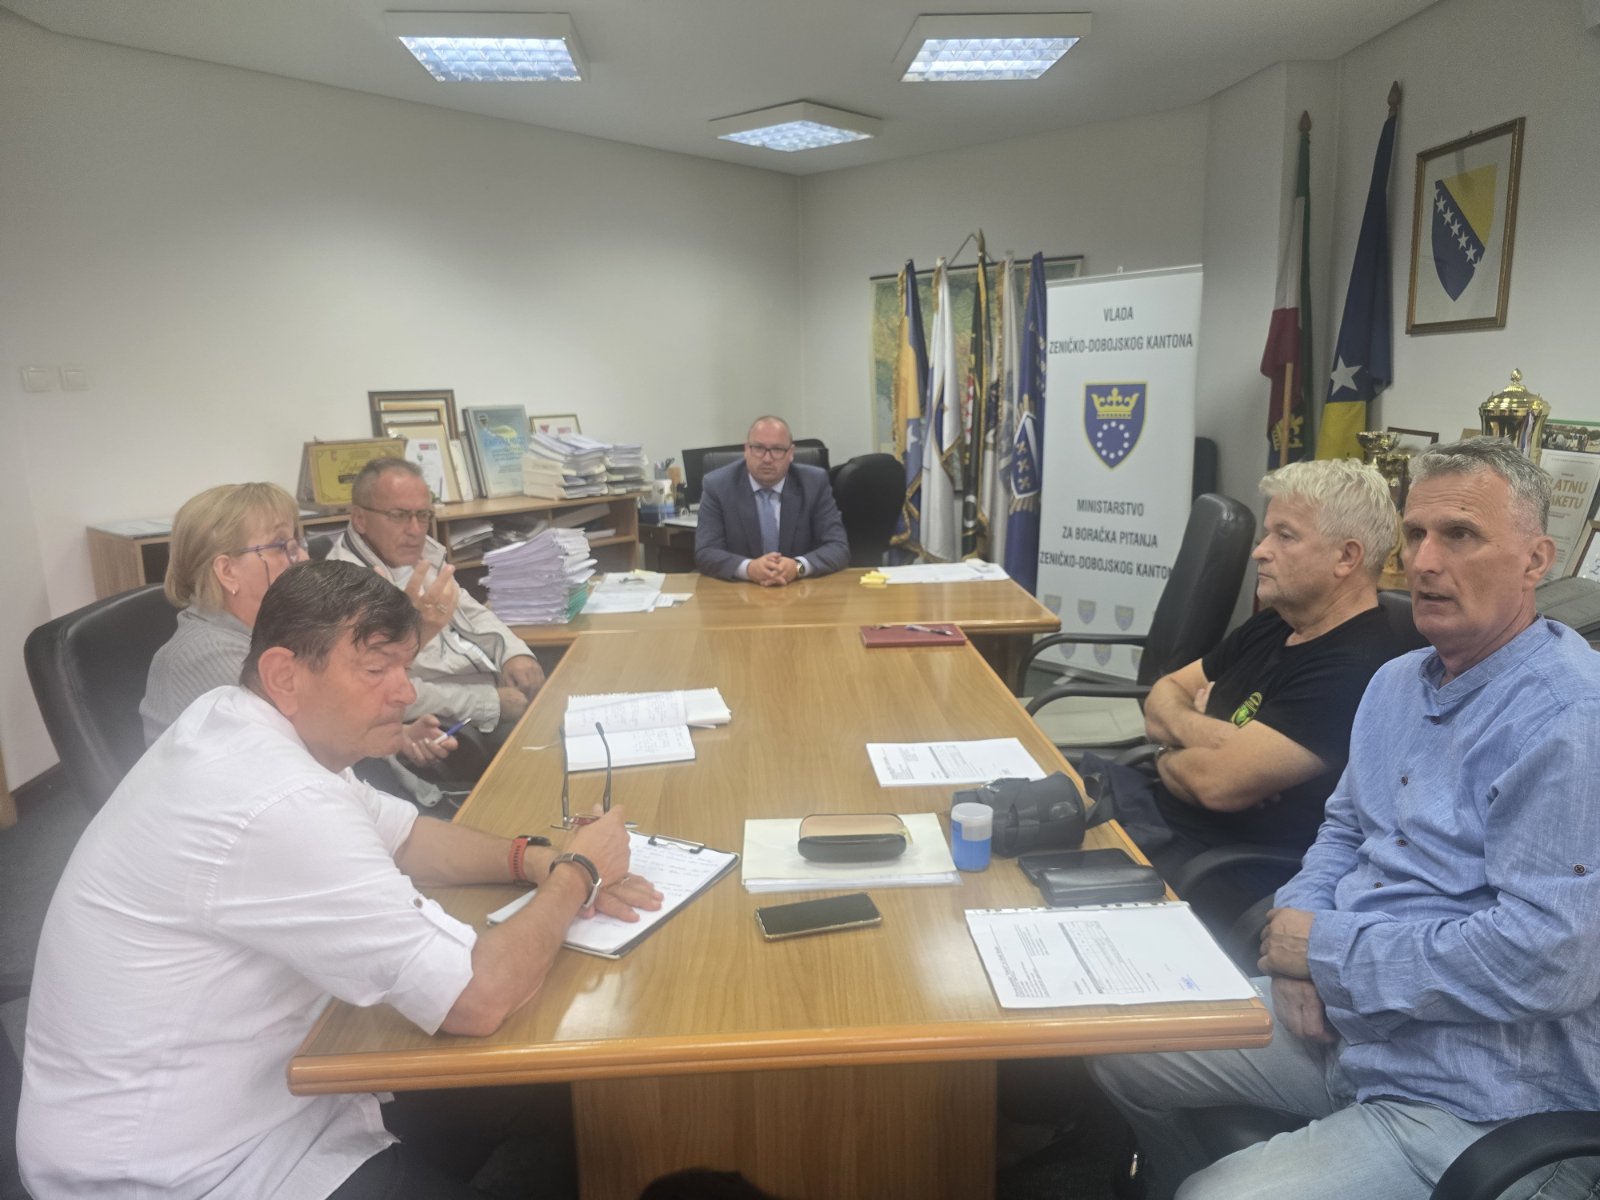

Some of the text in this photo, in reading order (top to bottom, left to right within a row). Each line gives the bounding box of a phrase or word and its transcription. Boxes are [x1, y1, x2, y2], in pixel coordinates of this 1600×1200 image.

[1103, 306, 1134, 322] VLADA
[1049, 333, 1193, 355] ZENIČKO-DOBOJSKOG KANTONA
[1552, 479, 1589, 494] ATNU
[1076, 499, 1144, 517] MINISTARSTVO
[1062, 526, 1158, 548] ZA BORAČKA PITANJA
[1039, 551, 1173, 579] ZENIČKO-DOBOJSKOG KANTO
